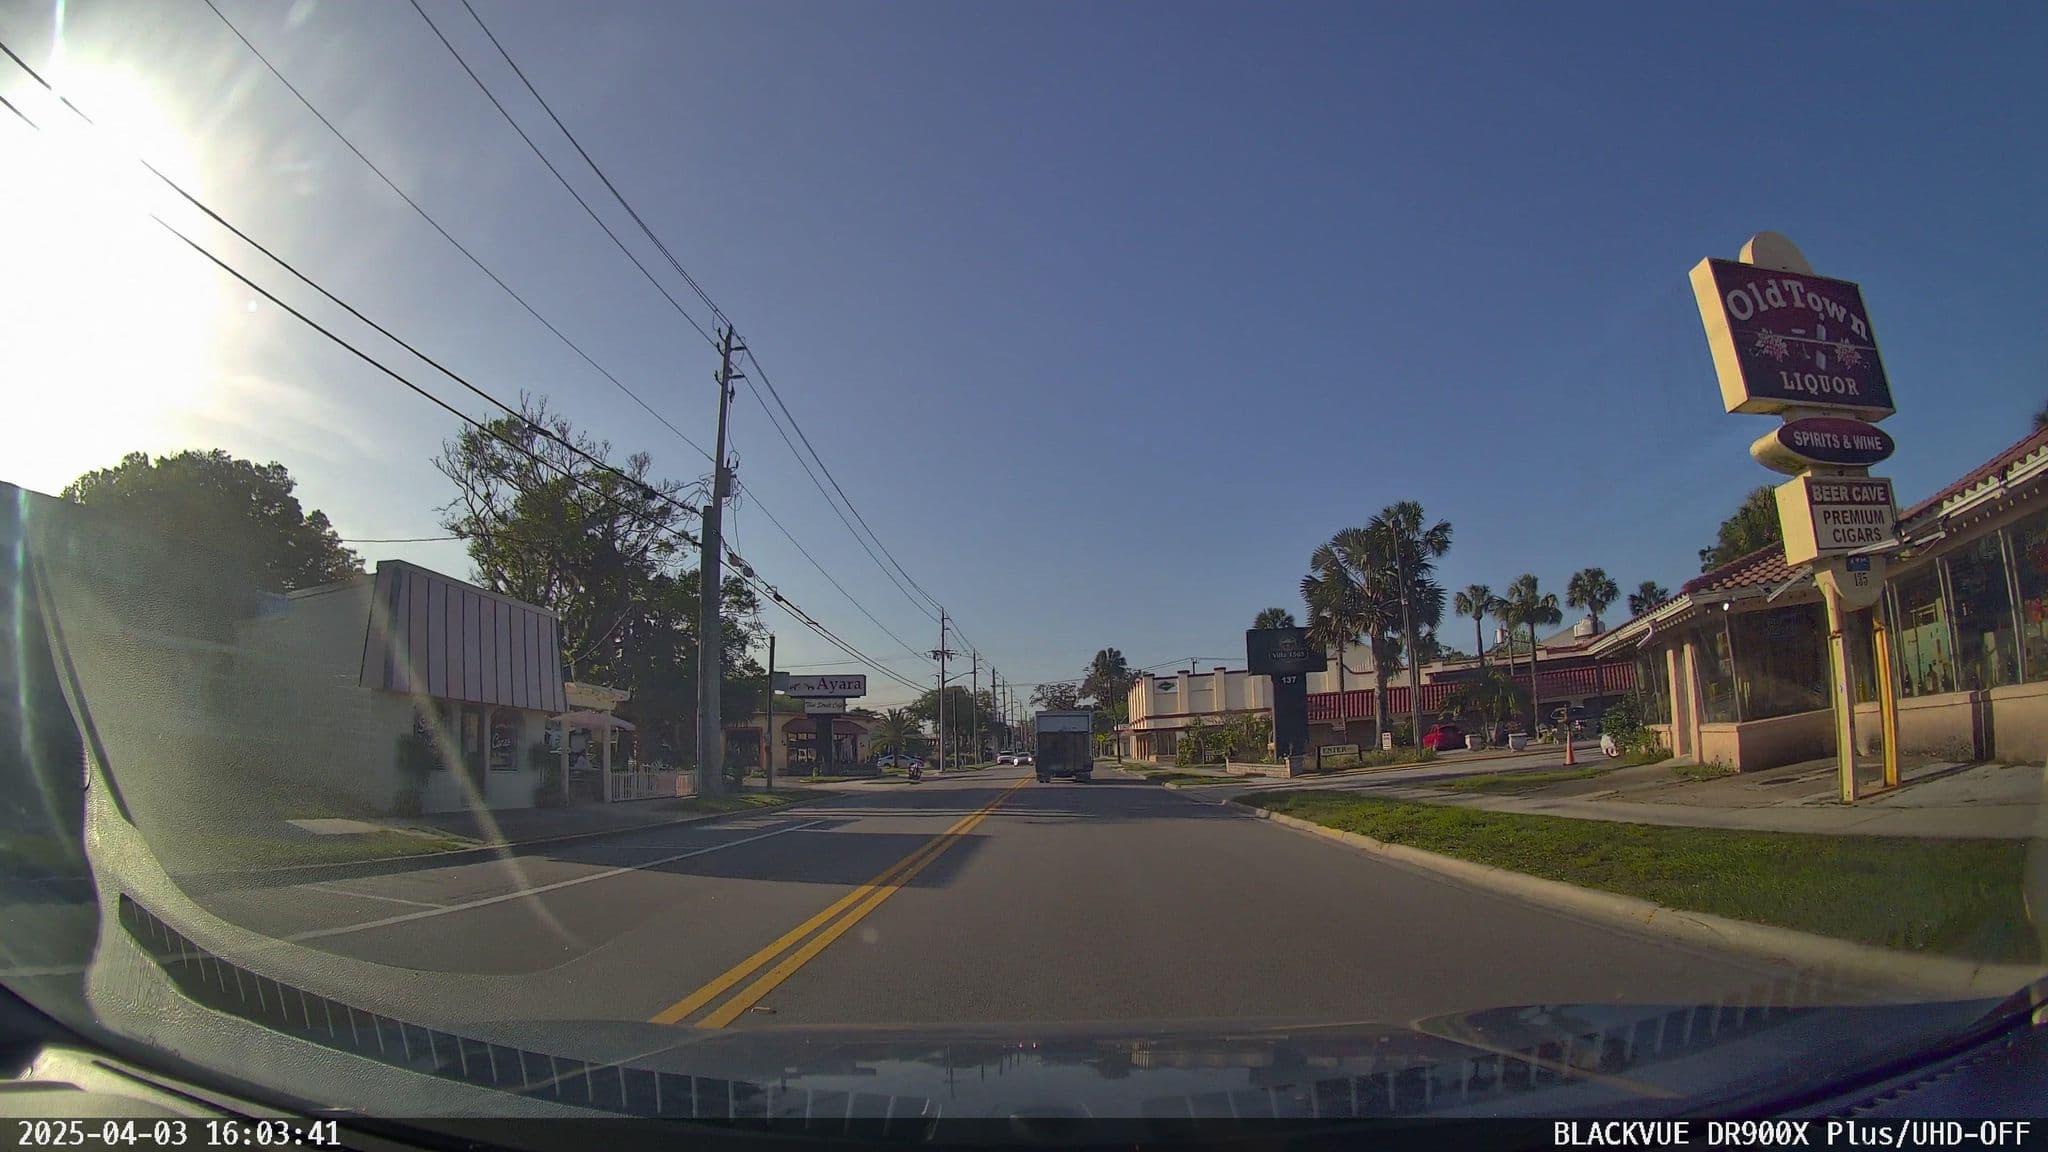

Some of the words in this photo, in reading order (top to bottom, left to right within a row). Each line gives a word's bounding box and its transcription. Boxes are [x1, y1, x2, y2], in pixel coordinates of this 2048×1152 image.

[1779, 371, 1860, 396] LIQUOR
[1793, 431, 1840, 449] SPIRITS
[1843, 437, 1852, 449] &
[1854, 436, 1883, 450] WINE
[1812, 485, 1850, 502] BEER
[1852, 485, 1886, 501] CAVE
[1823, 509, 1885, 525] PREMIUM
[1832, 528, 1882, 543] CIGARS
[817, 678, 862, 693] Ayara
[1281, 676, 1296, 684] 137
[1322, 746, 1347, 754] ENTER
